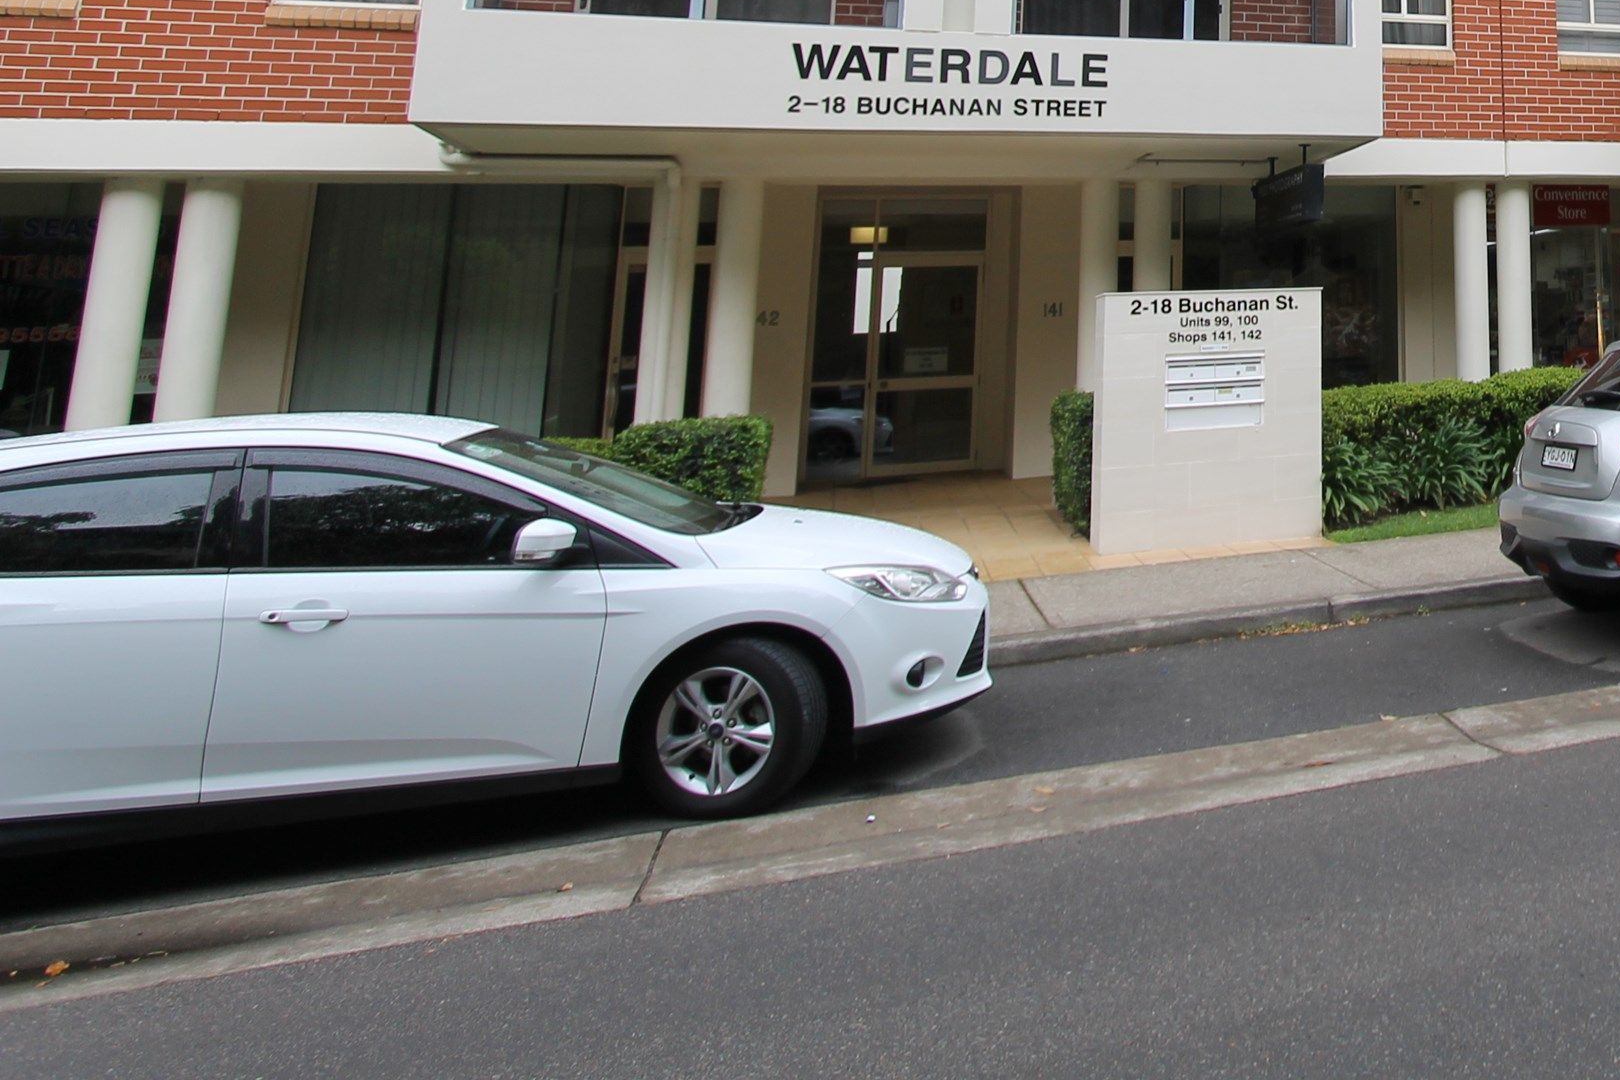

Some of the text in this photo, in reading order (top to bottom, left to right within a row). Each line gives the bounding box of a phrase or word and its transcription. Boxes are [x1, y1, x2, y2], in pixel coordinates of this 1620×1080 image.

[792, 43, 1109, 88] WATERDALE
[857, 97, 1002, 116] BUCHANAN
[1014, 98, 1108, 117] STREET
[1534, 186, 1609, 201] Convenience
[1557, 205, 1588, 219] Store
[1042, 302, 1063, 317] 141
[1130, 295, 1299, 316] 2-18 Buchanan St.
[755, 310, 780, 326] 42
[1180, 314, 1259, 328] Units 99, 100
[1168, 329, 1263, 345] Shops 141, 142
